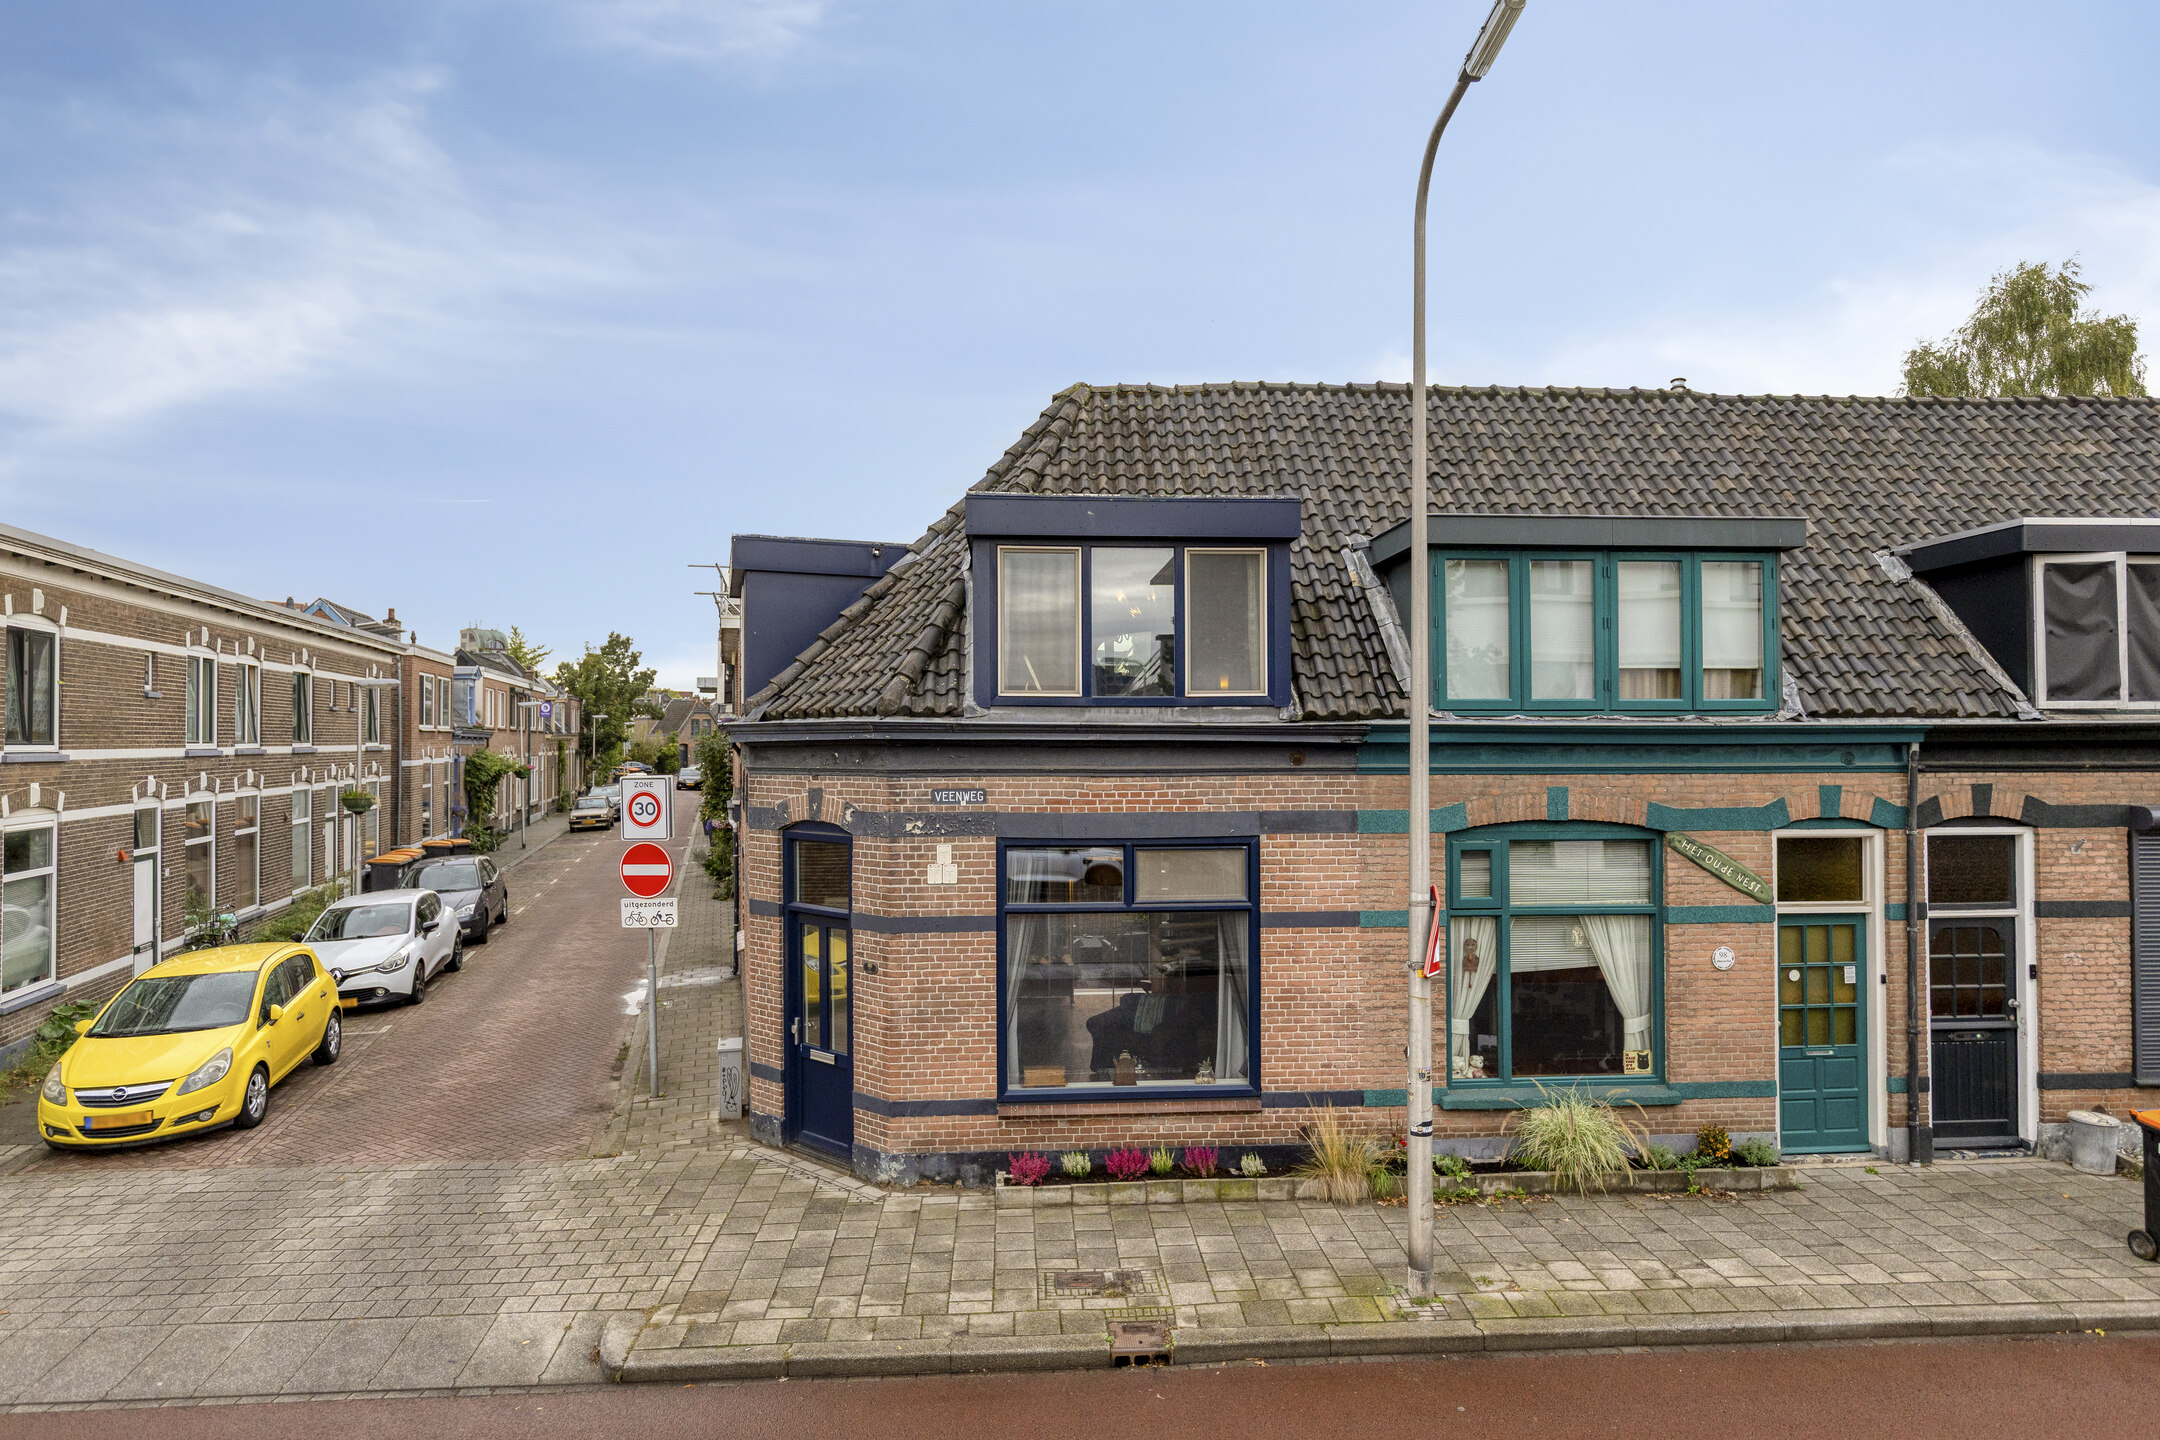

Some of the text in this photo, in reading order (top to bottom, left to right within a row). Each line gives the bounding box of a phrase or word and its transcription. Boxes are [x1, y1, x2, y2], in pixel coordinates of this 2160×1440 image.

[934, 791, 984, 802] VEENWEG
[634, 802, 656, 816] 30
[1681, 840, 1703, 857] HET
[1736, 872, 1761, 893] NEST
[624, 901, 674, 909] uitgezonderd
[1719, 951, 1728, 959] 98
